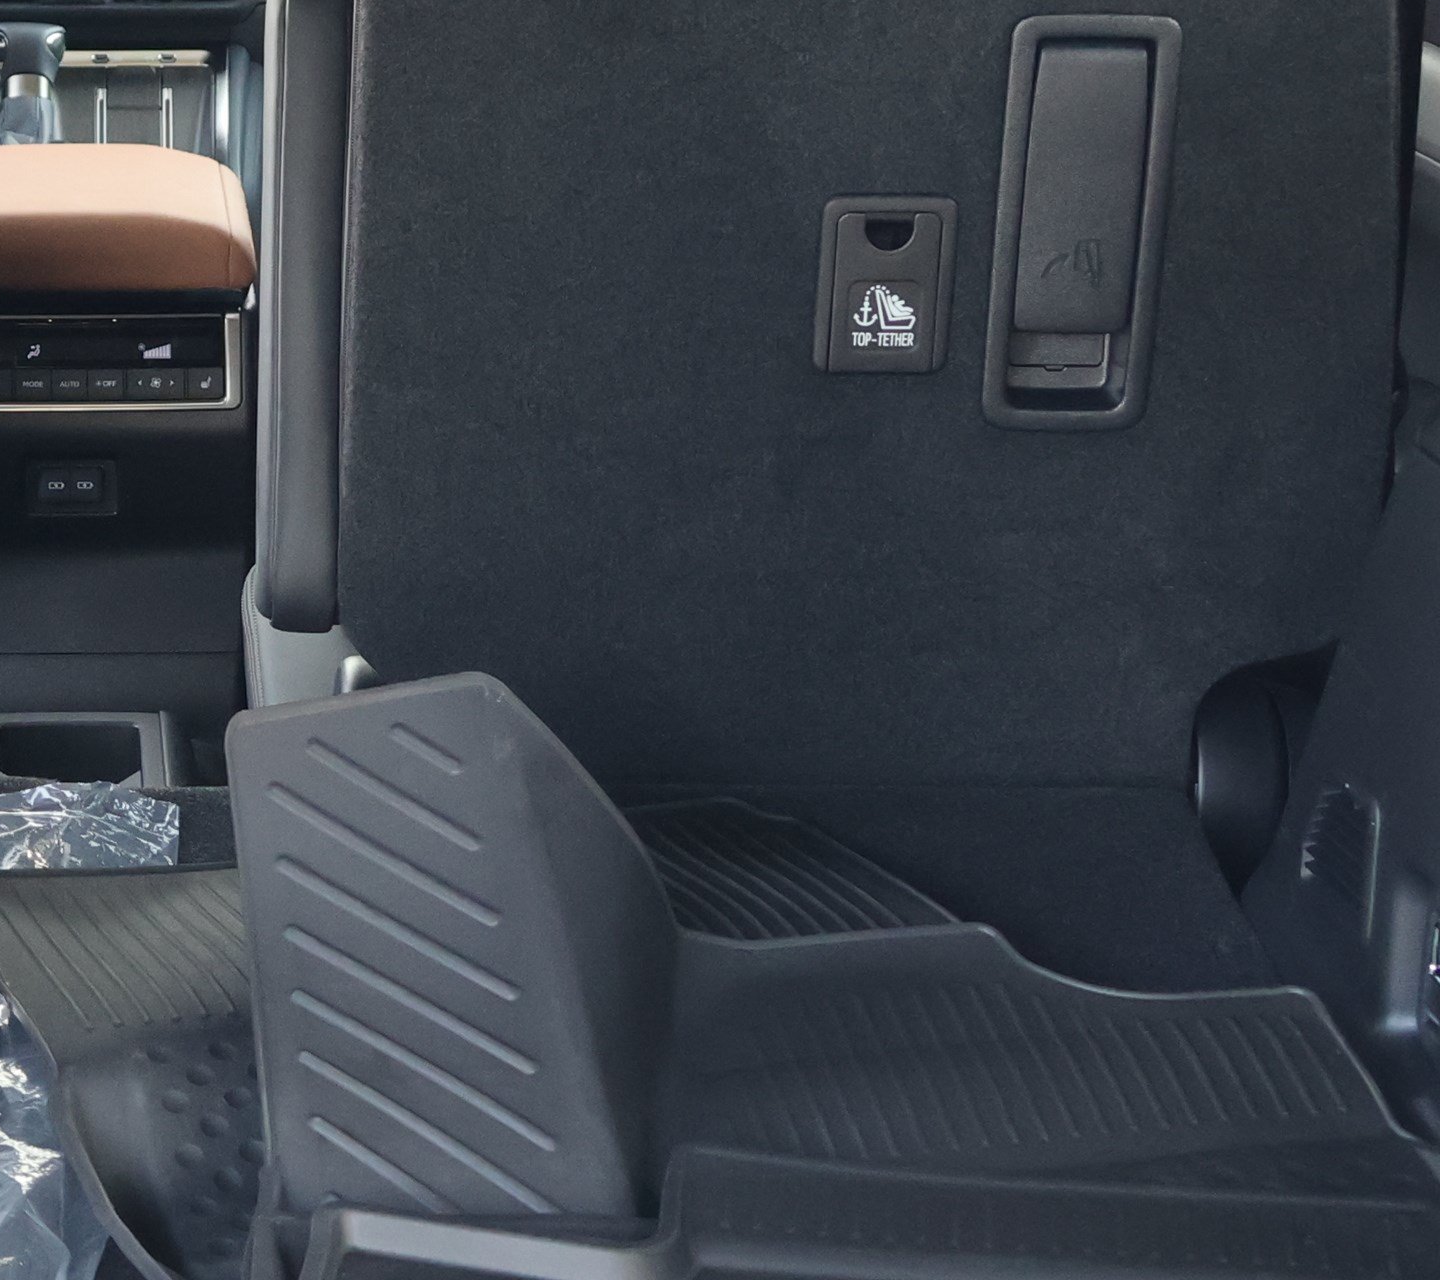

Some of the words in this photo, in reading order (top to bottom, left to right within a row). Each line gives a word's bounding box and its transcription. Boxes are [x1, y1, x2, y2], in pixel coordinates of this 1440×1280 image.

[851, 331, 915, 347] TOP-TETHER
[22, 380, 44, 388] MODE
[59, 380, 80, 388] AUTO
